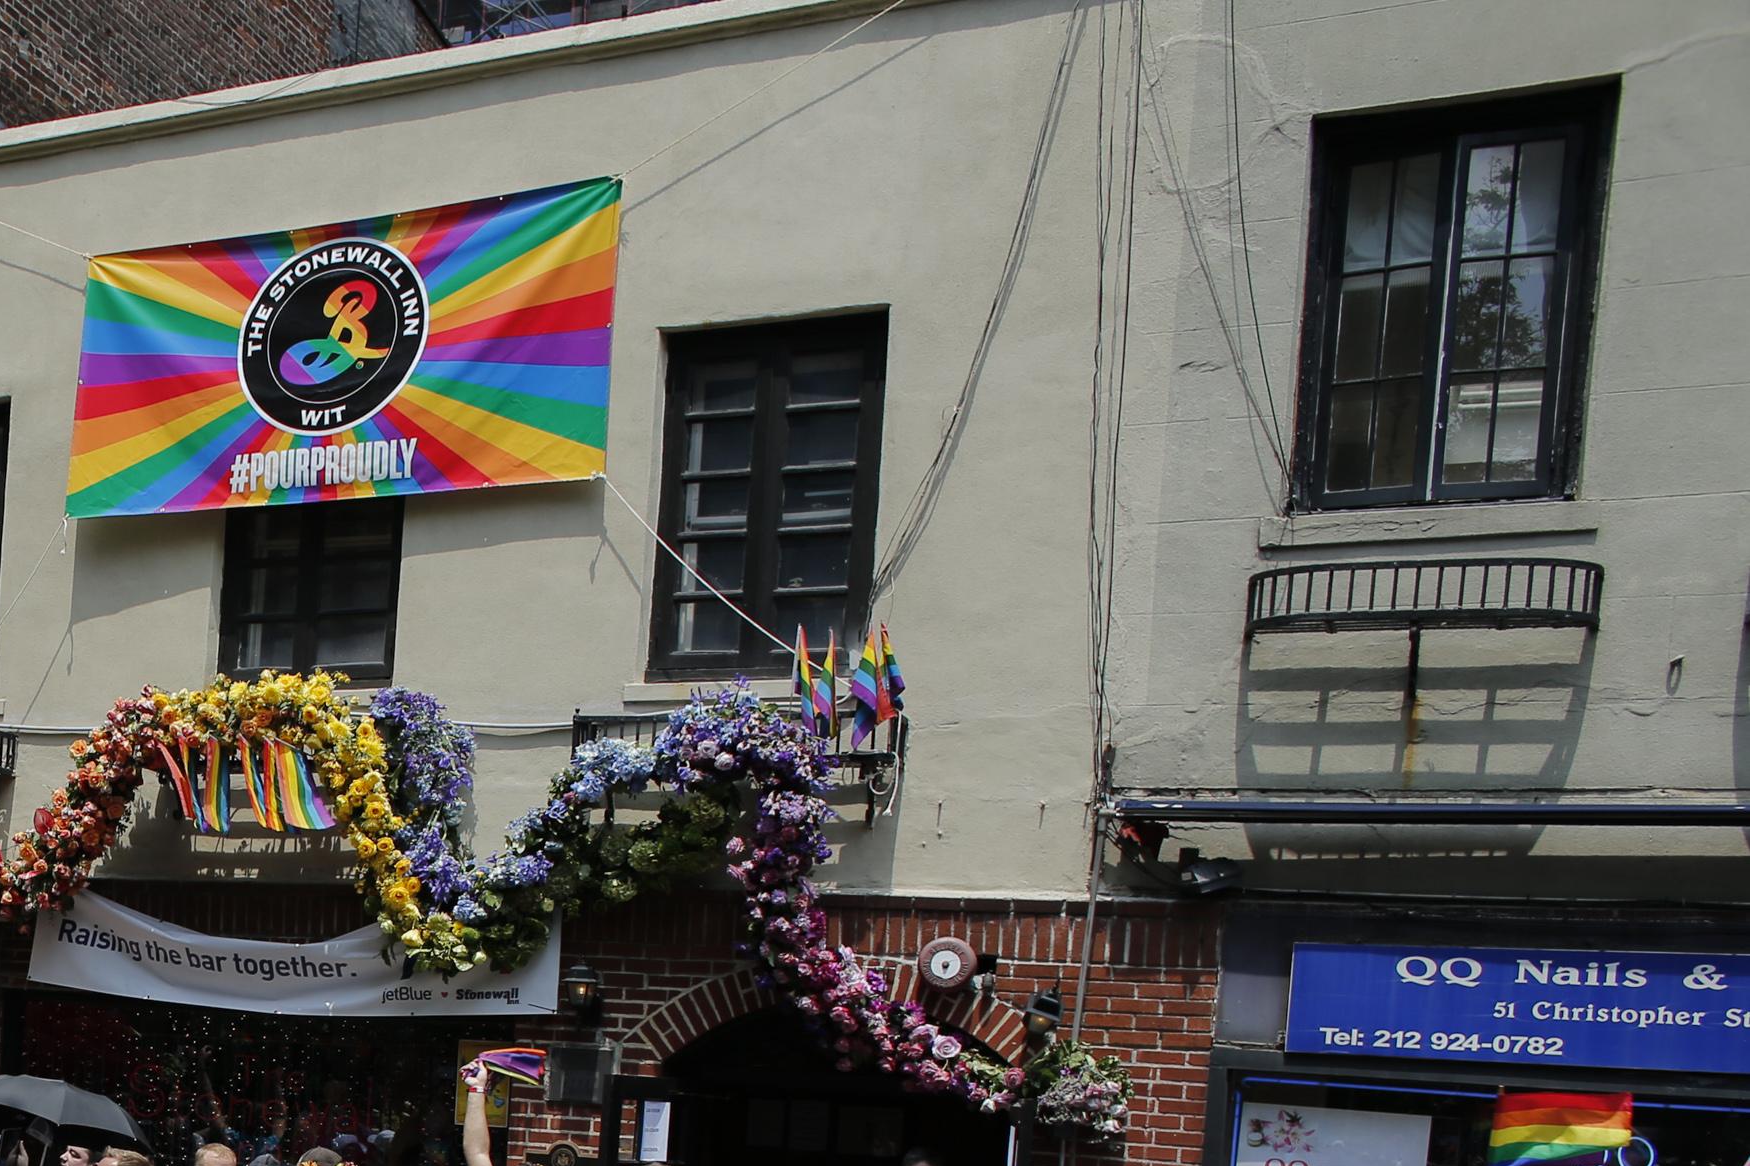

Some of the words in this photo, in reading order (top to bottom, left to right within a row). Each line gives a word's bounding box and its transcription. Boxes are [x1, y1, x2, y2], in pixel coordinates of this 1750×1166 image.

[248, 304, 273, 357] THE
[270, 247, 403, 302] STONEWALL
[400, 288, 419, 336] INN
[301, 405, 346, 426] WIT
[229, 437, 418, 494] #POURPROUDLY
[57, 918, 143, 962] Raising
[145, 941, 182, 965] the
[186, 948, 228, 973] bar
[233, 953, 358, 981] together.
[1395, 956, 1482, 988] QQ
[1514, 959, 1648, 988] Nails
[1682, 964, 1729, 991] &
[381, 986, 432, 1004] jetBlue
[455, 987, 519, 1000] Stonewall
[1492, 1001, 1515, 1018] 51
[1531, 1001, 1707, 1028] Christopher
[1319, 1027, 1364, 1046] Tel:
[1372, 1030, 1421, 1049] 212
[1430, 1032, 1564, 1056] 924-0782
